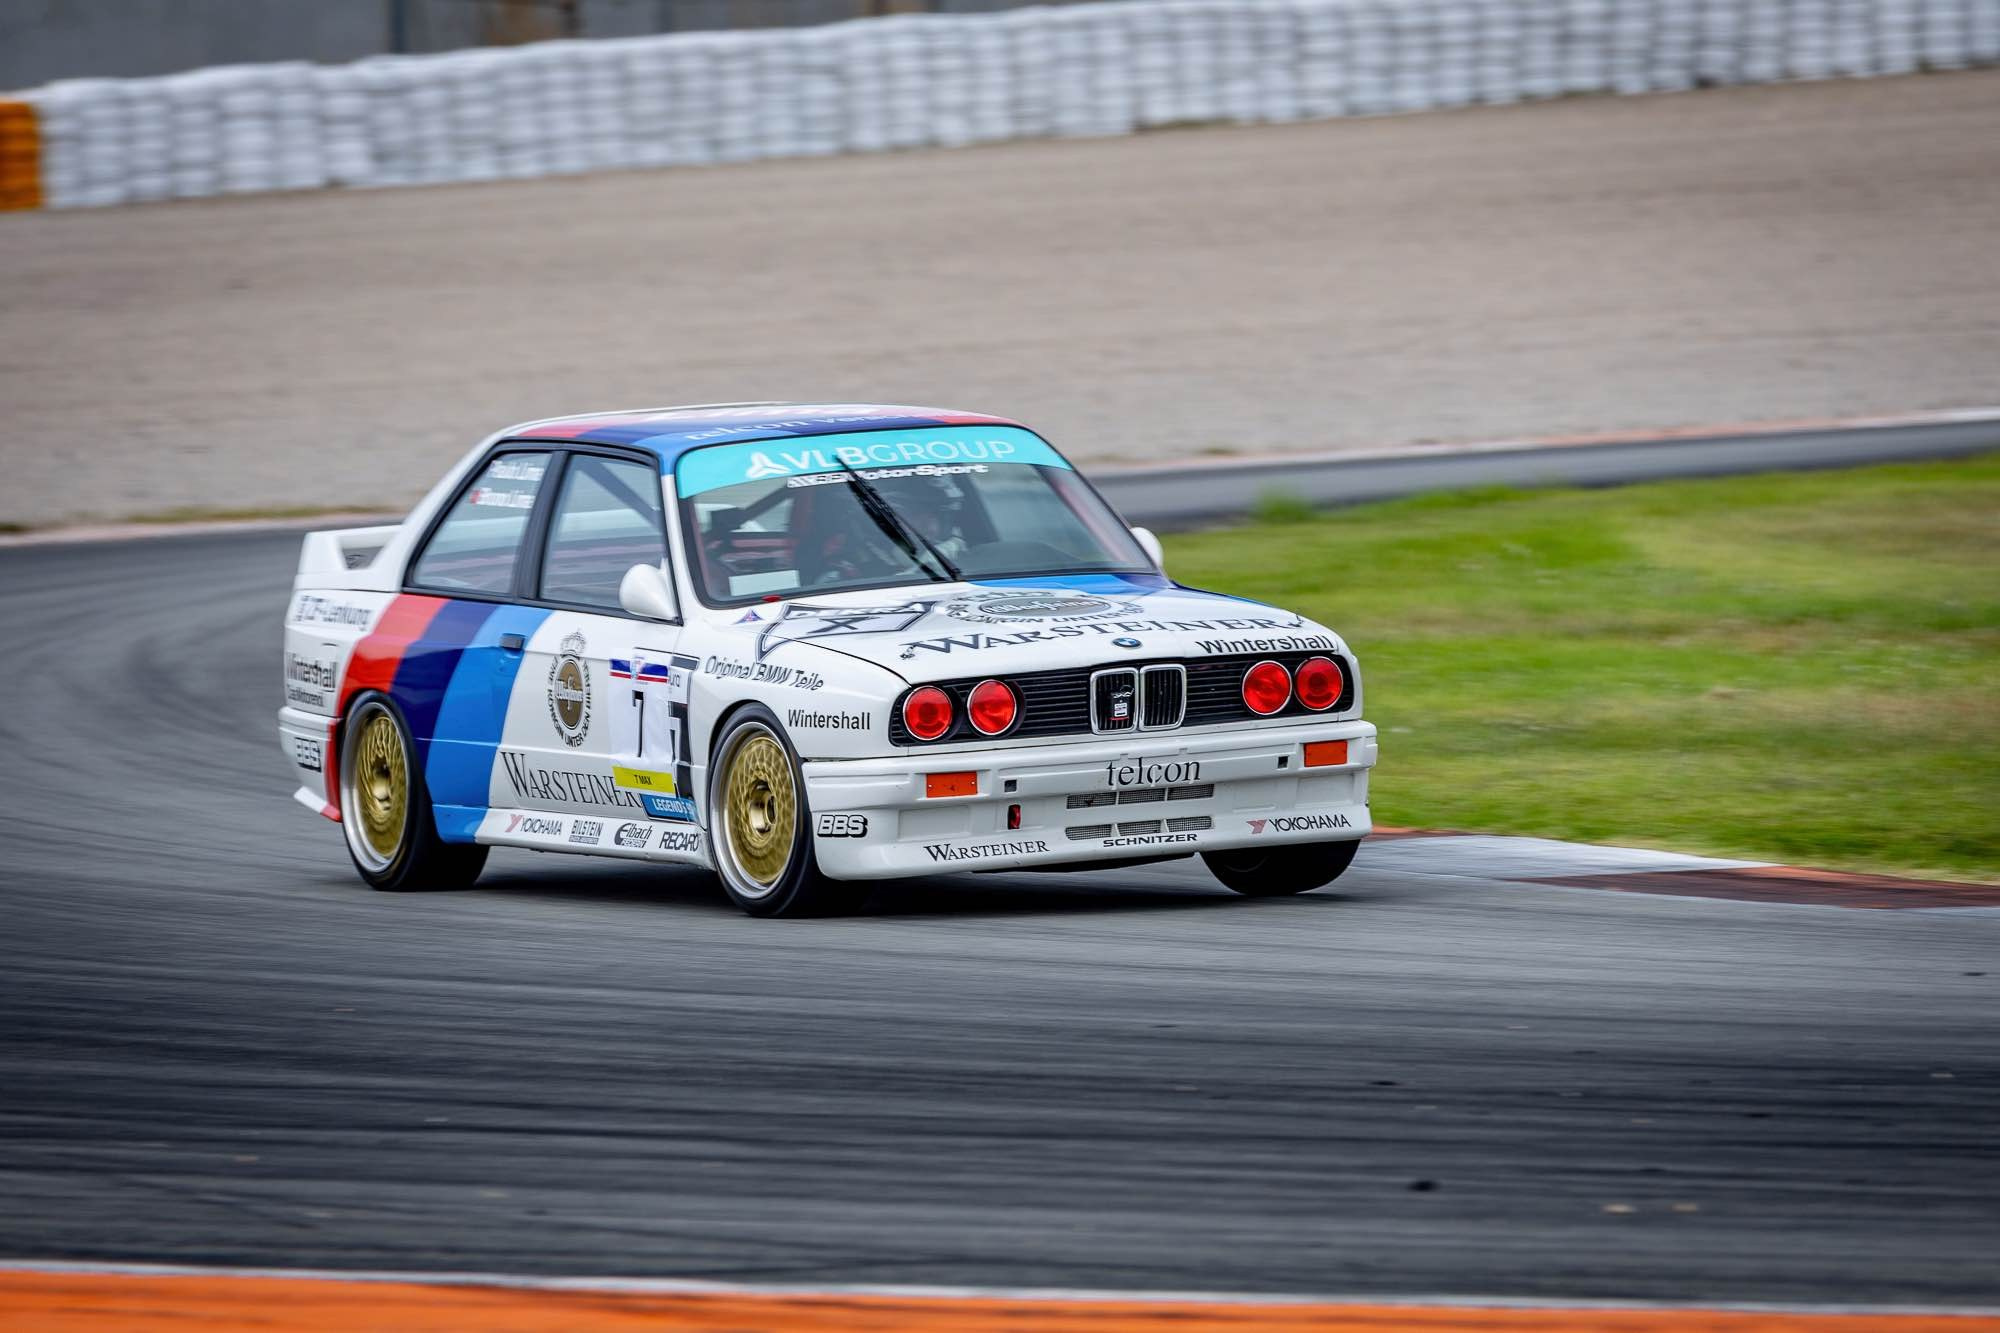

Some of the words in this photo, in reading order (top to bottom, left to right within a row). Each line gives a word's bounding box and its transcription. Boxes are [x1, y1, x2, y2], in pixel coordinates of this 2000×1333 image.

[783, 440, 1016, 470] VLBGROUP
[785, 604, 926, 620] DEKRA
[900, 615, 1304, 657] WARSTEINER
[1195, 634, 1335, 655] Wintershall
[703, 655, 754, 680] Original
[752, 663, 794, 686] BMW
[793, 670, 825, 691] Teile
[632, 689, 644, 758] 7
[787, 708, 871, 730] Wintershall
[1106, 757, 1201, 787] telcon
[520, 817, 563, 836] YOKOHAMA
[571, 819, 604, 837] BILSTEIN
[614, 822, 658, 846] Eibach
[817, 814, 868, 838] BBS
[1268, 814, 1352, 833] YOKOHAMA
[659, 831, 700, 852] RECARO
[924, 840, 1051, 862] WARSTEINER
[1103, 833, 1198, 848] SCHNITZER
